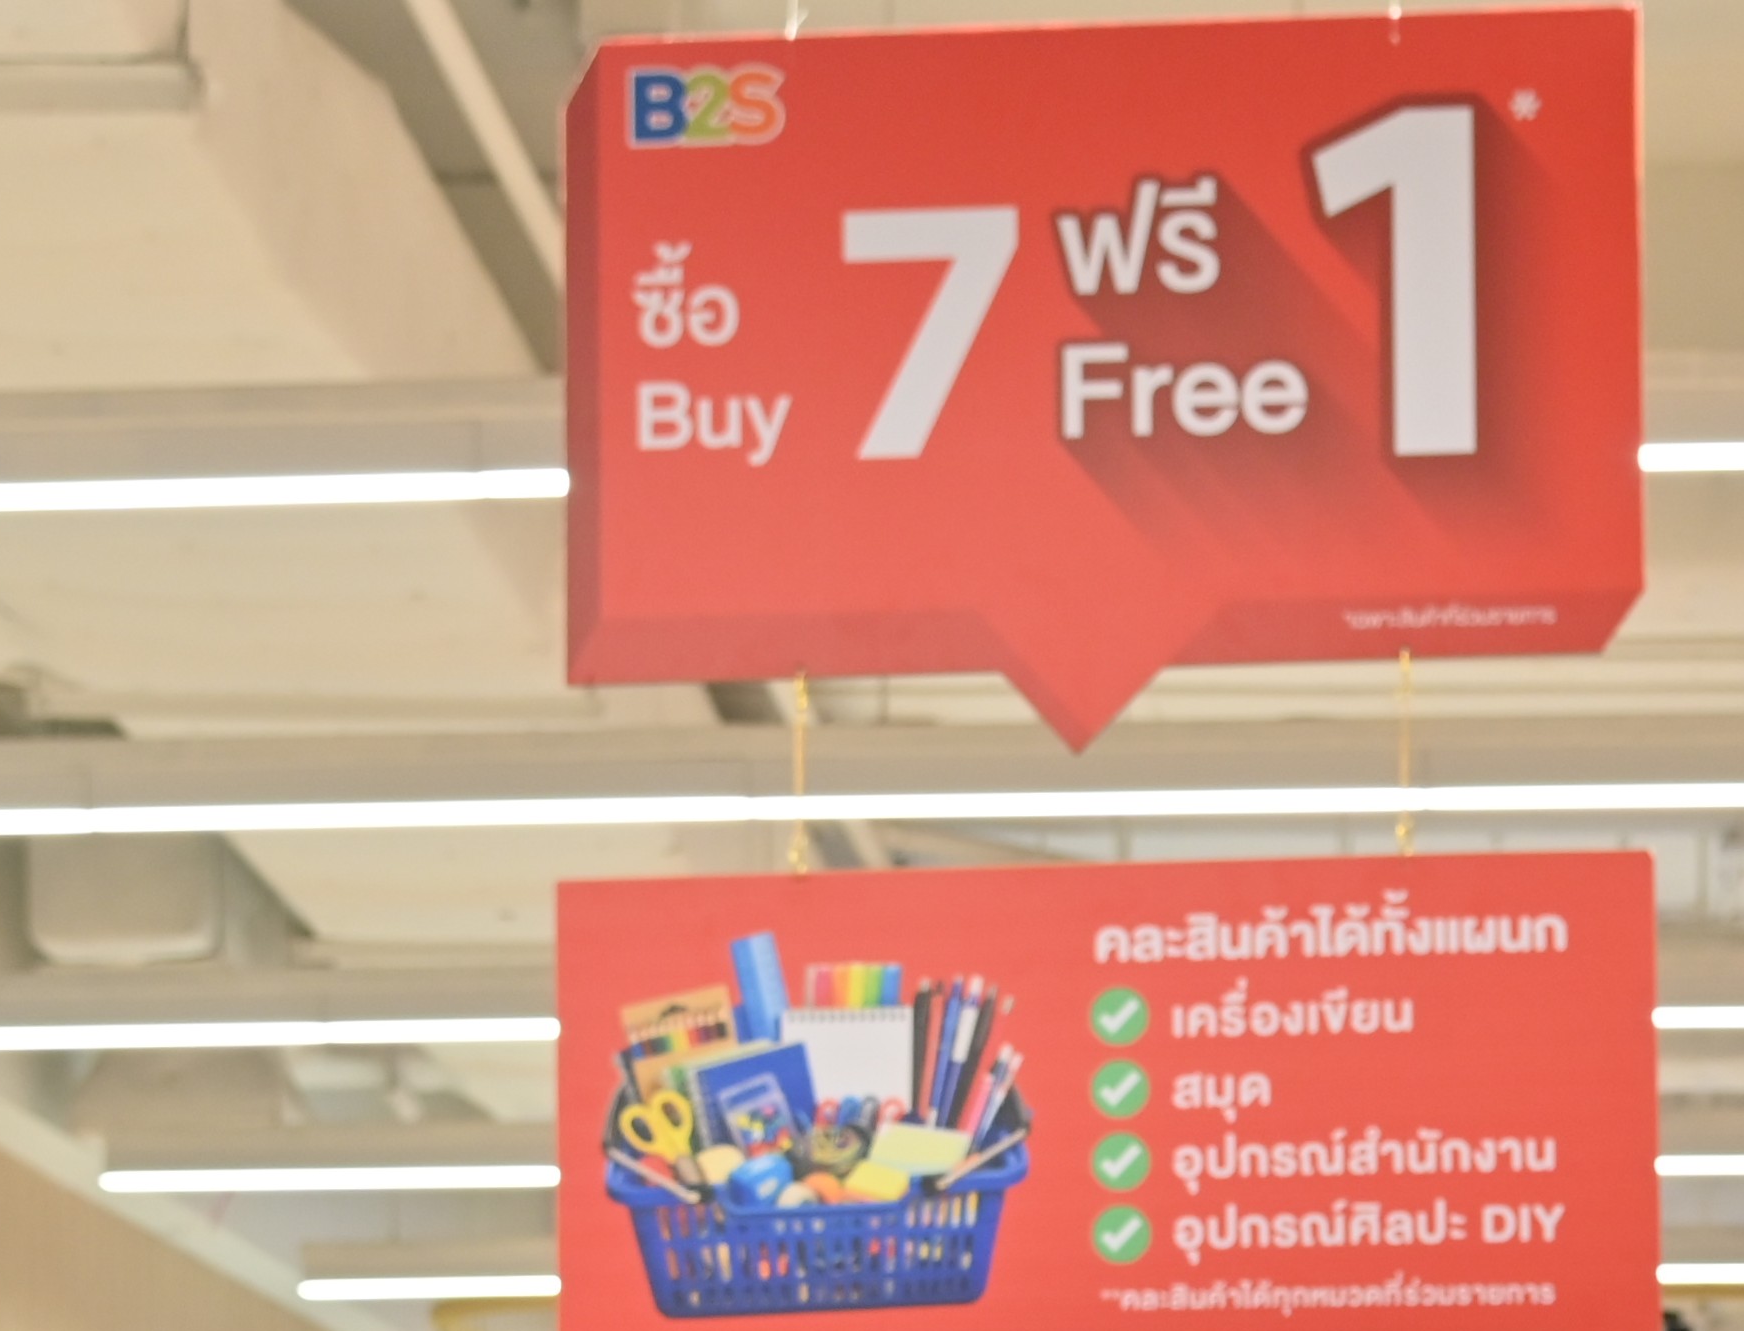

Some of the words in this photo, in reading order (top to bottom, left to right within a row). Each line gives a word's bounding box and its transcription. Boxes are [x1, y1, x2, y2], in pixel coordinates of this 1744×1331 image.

[626, 62, 786, 149] B2S
[633, 242, 740, 347] ซื้อ
[842, 207, 1019, 459] 7
[1059, 176, 1221, 294] ฟรี
[1312, 104, 1476, 456] 1
[637, 383, 791, 465] Buy
[1061, 343, 1307, 439] Free
[1094, 890, 1569, 964] คละสินค้าได้ทั้งแผนก
[1171, 977, 1414, 1038] เครื่องเขียน
[1172, 1072, 1271, 1123] สมุด
[1173, 1126, 1556, 1195] อุปกรณ์สำนักงาน
[1174, 1199, 1467, 1265] อุปกรณ์ศิลปะ
[1482, 1204, 1564, 1242] DIY
